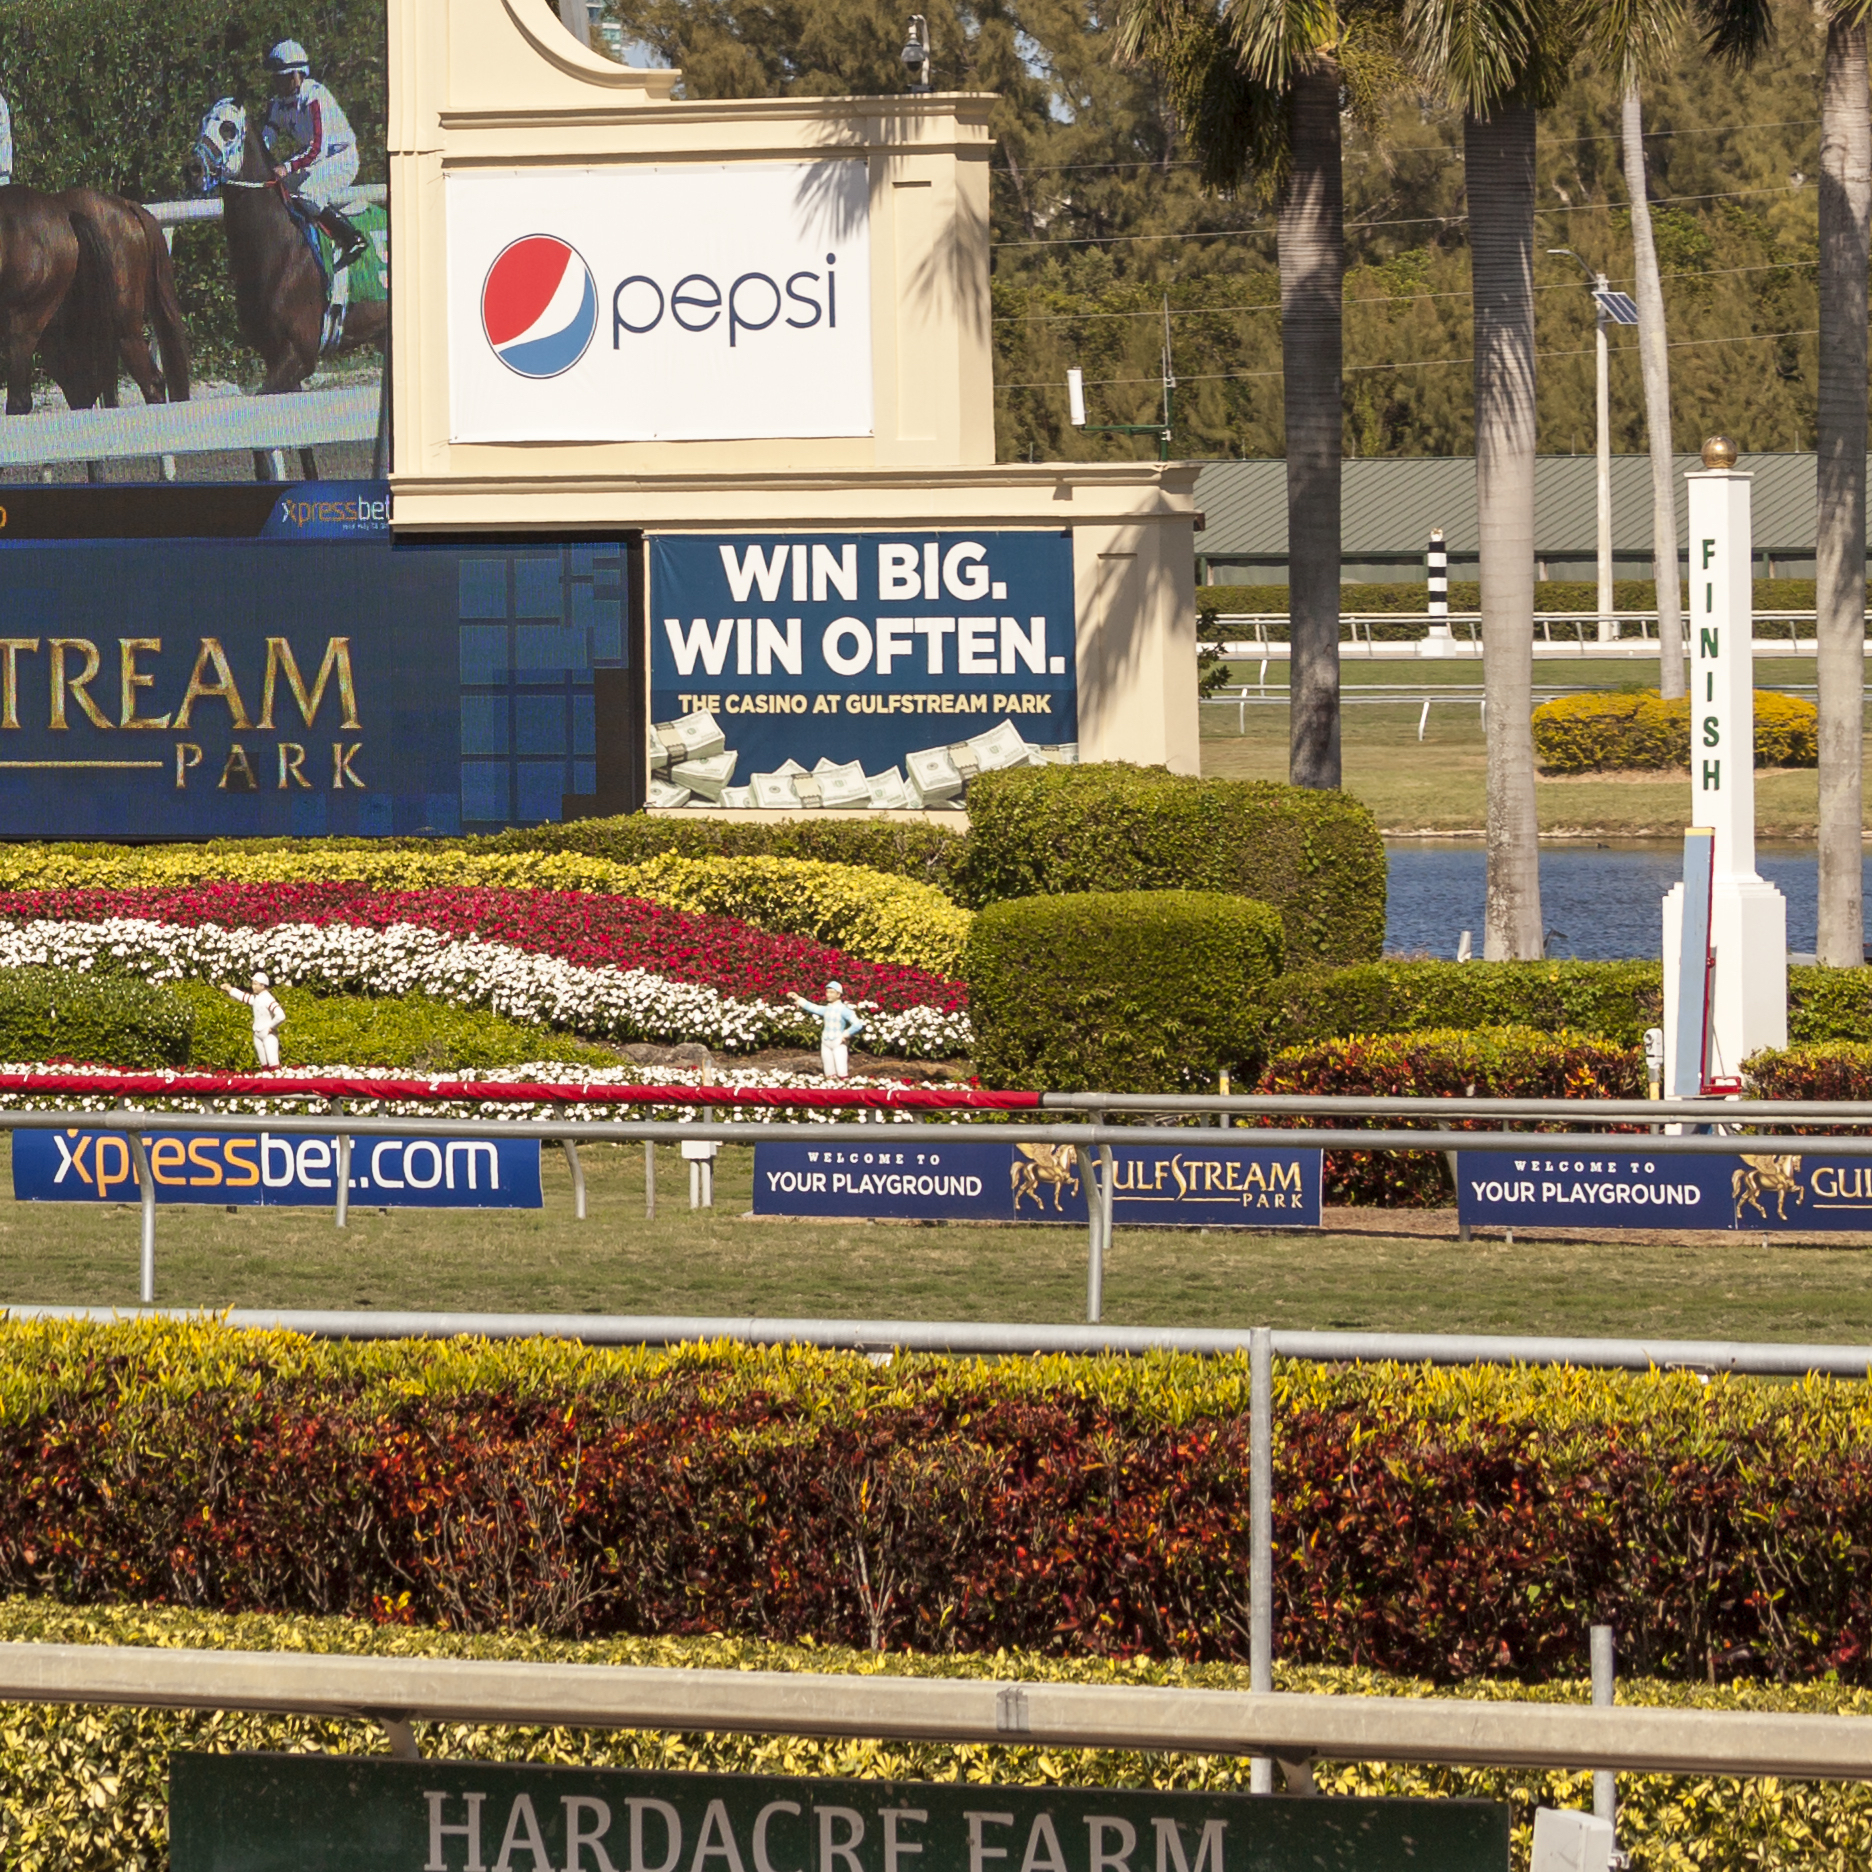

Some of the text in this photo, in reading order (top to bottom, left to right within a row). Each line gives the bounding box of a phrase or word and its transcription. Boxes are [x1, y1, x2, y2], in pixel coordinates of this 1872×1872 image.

[612, 252, 838, 350] pepsi
[719, 541, 1008, 602] WIN BIG.
[664, 616, 1066, 676] WIN OFTEN.
[1700, 538, 1721, 792] FINISH
[678, 693, 1052, 714] THE CASINO AT GULFSTREAM PARK
[175, 742, 366, 790] PARK
[808, 1151, 941, 1166] WELCOME TO
[1092, 1152, 1303, 1201] ULFSTREAM
[1514, 1160, 1655, 1174] WELCOME TO
[766, 1171, 983, 1197] YOUR PLAYGROUND
[1243, 1192, 1303, 1209] PARK
[1471, 1181, 1701, 1206] YOUR PLAYGROUND
[423, 1790, 1229, 1872] HARDACRE FARM
